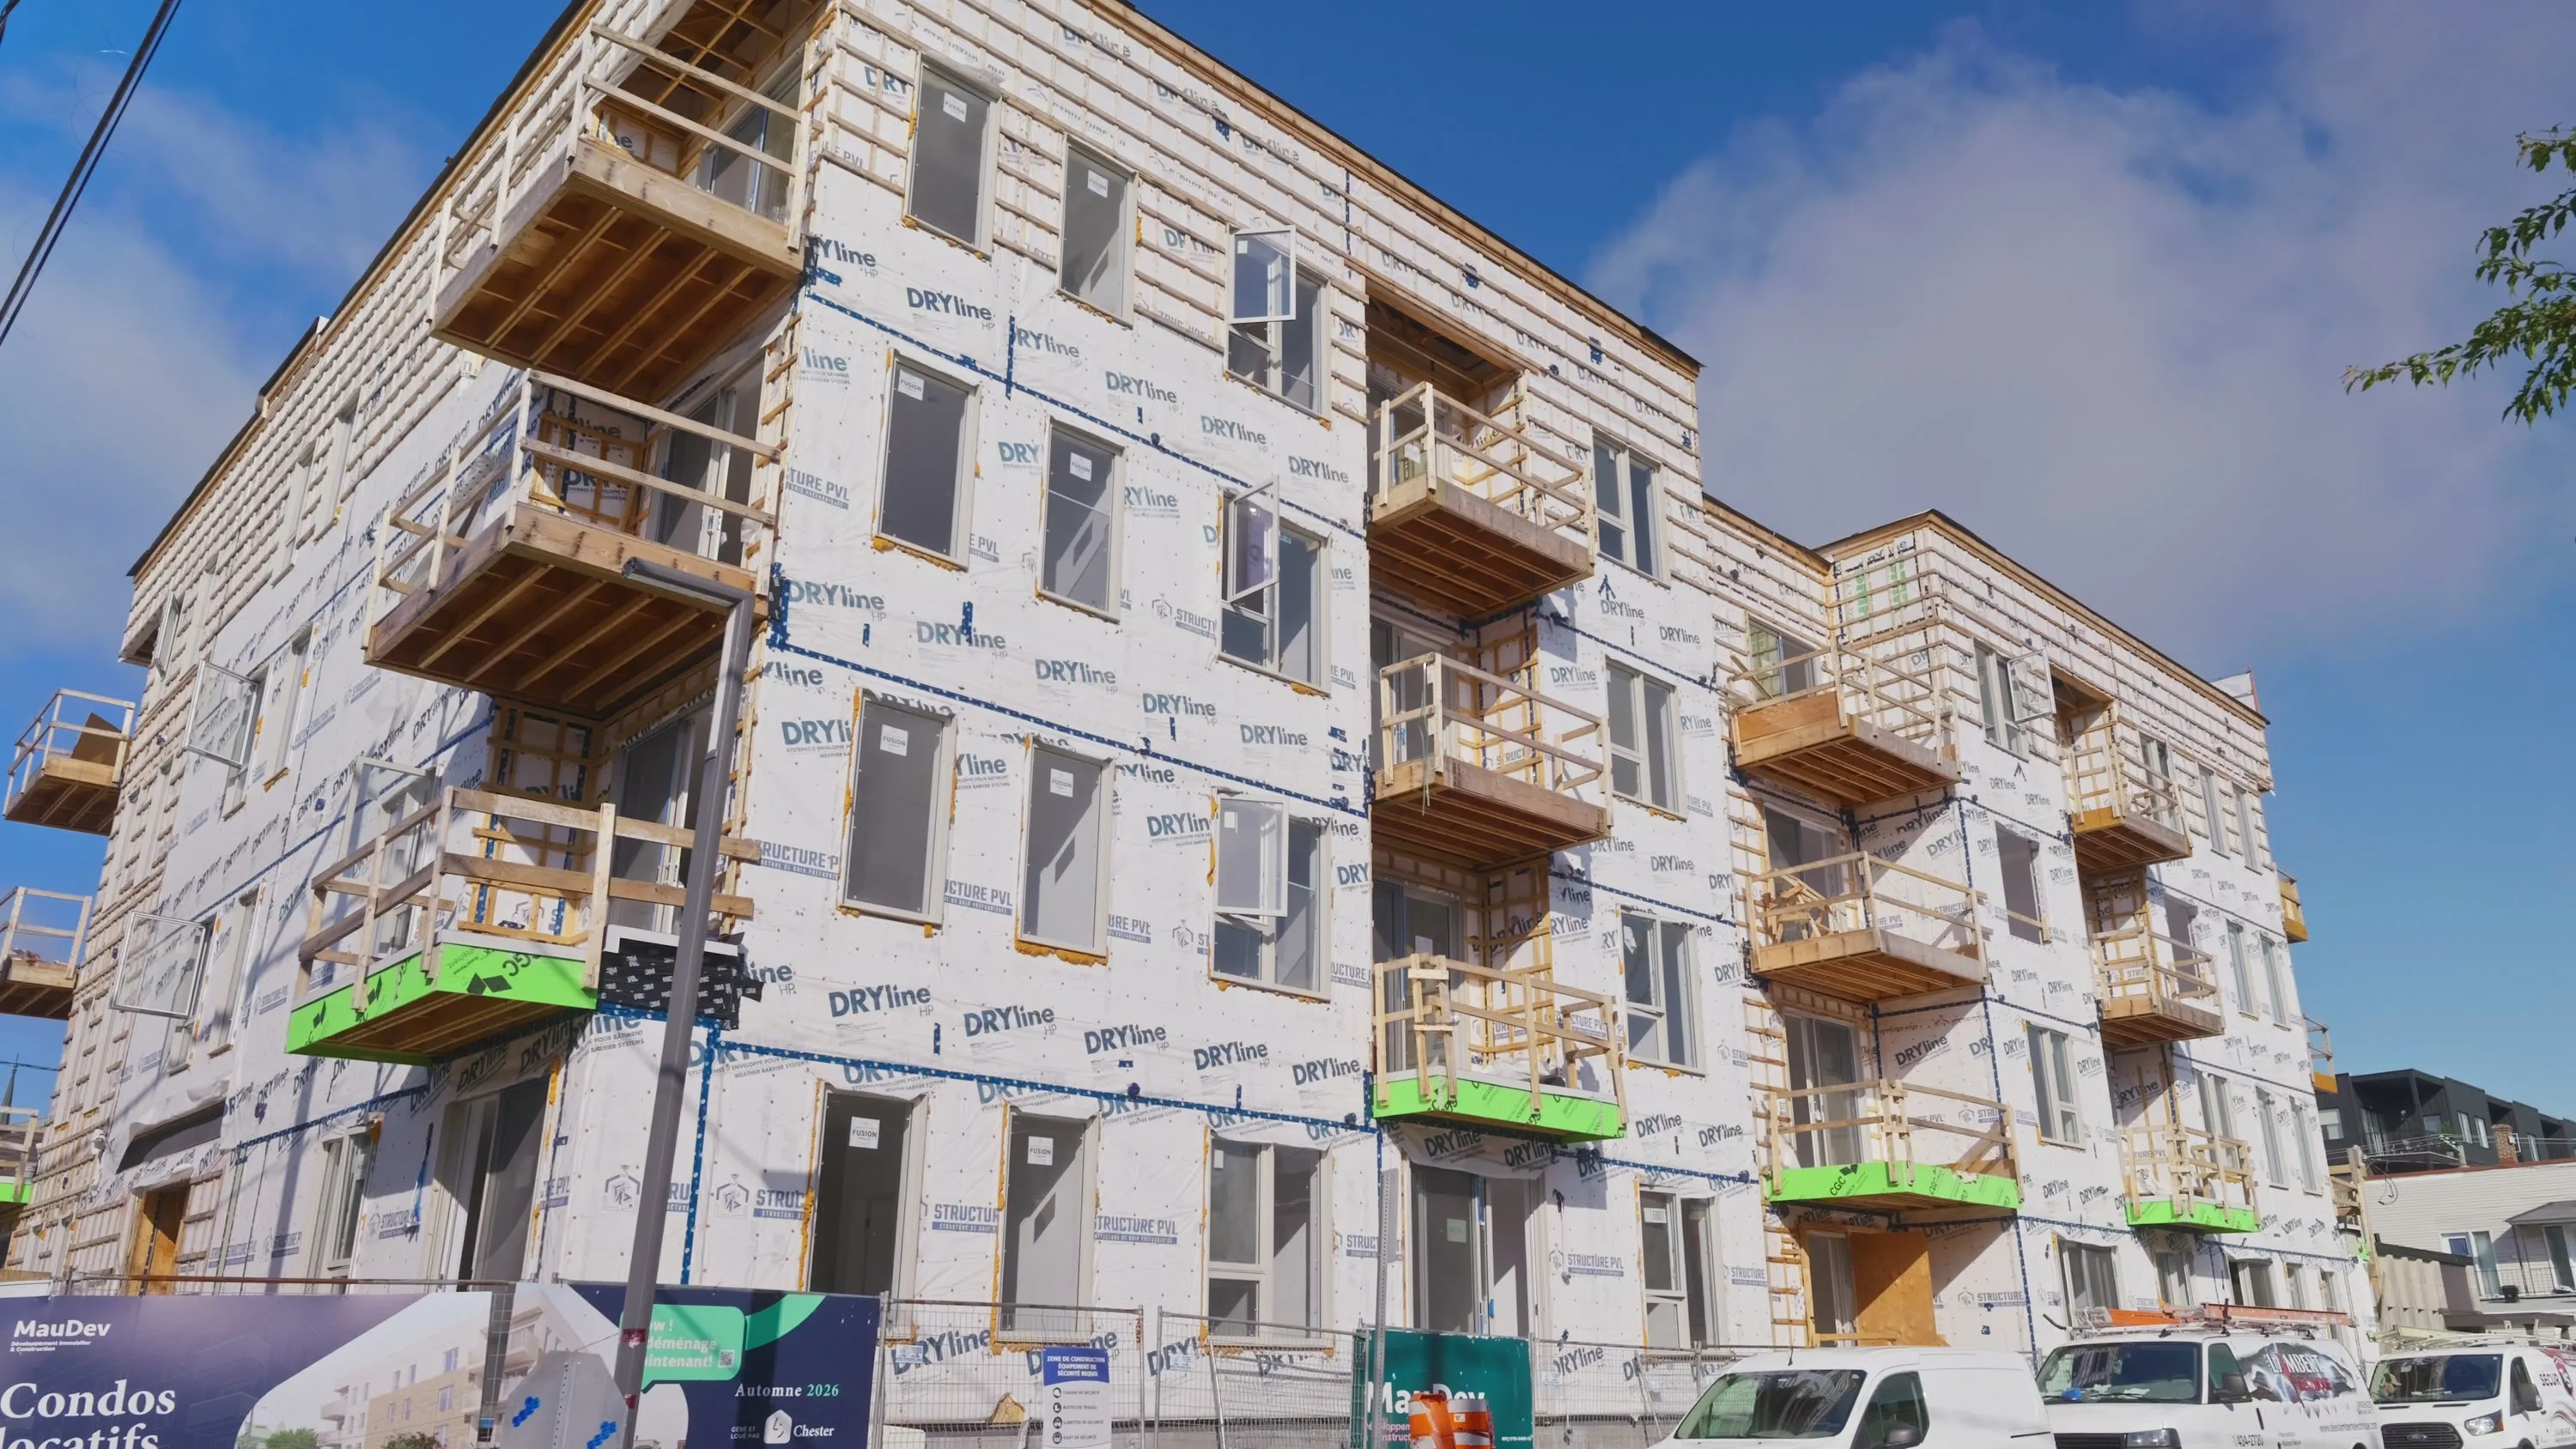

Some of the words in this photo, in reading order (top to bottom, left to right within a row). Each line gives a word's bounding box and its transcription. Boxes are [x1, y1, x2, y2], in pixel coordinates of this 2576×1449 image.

[907, 288, 992, 321] DRYline
[901, 379, 922, 392] FUSION
[1105, 371, 1177, 403] DRYline
[1201, 415, 1267, 445] DRYline
[435, 421, 470, 471] DRYline
[1072, 462, 1090, 473] FUSION
[1289, 456, 1349, 483] DRYline
[827, 482, 849, 501] PVL
[978, 537, 999, 555] PVL
[789, 580, 885, 610] DRYline
[872, 611, 886, 622] HP
[1601, 598, 1644, 619] DRYline
[1660, 626, 1700, 644] DRYline
[993, 651, 1008, 660] HP
[1036, 659, 1115, 684] DRYline
[1341, 666, 1356, 682] PVL
[1550, 666, 1596, 683] DRYline
[1143, 693, 1216, 717] DRYline
[883, 735, 906, 747] FUSION
[1241, 724, 1308, 746] DRYline
[1052, 779, 1072, 788] FUSION
[1990, 778, 2015, 790] DRYline
[1650, 856, 1694, 872] DRYline
[991, 889, 1012, 906] PVL
[1132, 920, 1151, 936] PVL
[2012, 970, 2038, 982] DRYline
[780, 983, 794, 995] HP
[829, 985, 931, 1017] DRYline
[919, 1005, 933, 1016] HP
[964, 1004, 1054, 1037] DRYline
[612, 1030, 643, 1041] BÂTIMENT
[1044, 1024, 1057, 1035] HP
[617, 1039, 645, 1048] SYSTEMS
[1084, 1024, 1166, 1054] DRYline
[1157, 1041, 1170, 1052] HP
[1194, 1041, 1268, 1070] DRYline
[1896, 1035, 1947, 1064] DRYline
[734, 1068, 758, 1079] WEATHER
[759, 1064, 783, 1076] BARRIER
[1293, 1058, 1360, 1086] DRYline
[2077, 1057, 2101, 1073] DRYline
[852, 1129, 877, 1138] FUSION
[1636, 1113, 1681, 1138] DRYline
[1425, 1128, 1482, 1158] DRYline
[1830, 1176, 1847, 1197] CGC
[1157, 1219, 1178, 1235] PVL
[1568, 1253, 1608, 1268] STRUCTURE
[1610, 1257, 1624, 1270] PVL
[14, 1319, 112, 1338] MauDev
[0, 1379, 176, 1418] Condos
[735, 1384, 802, 1397] Automne
[806, 1384, 839, 1397] 2026
[793, 1425, 835, 1438] Chester
